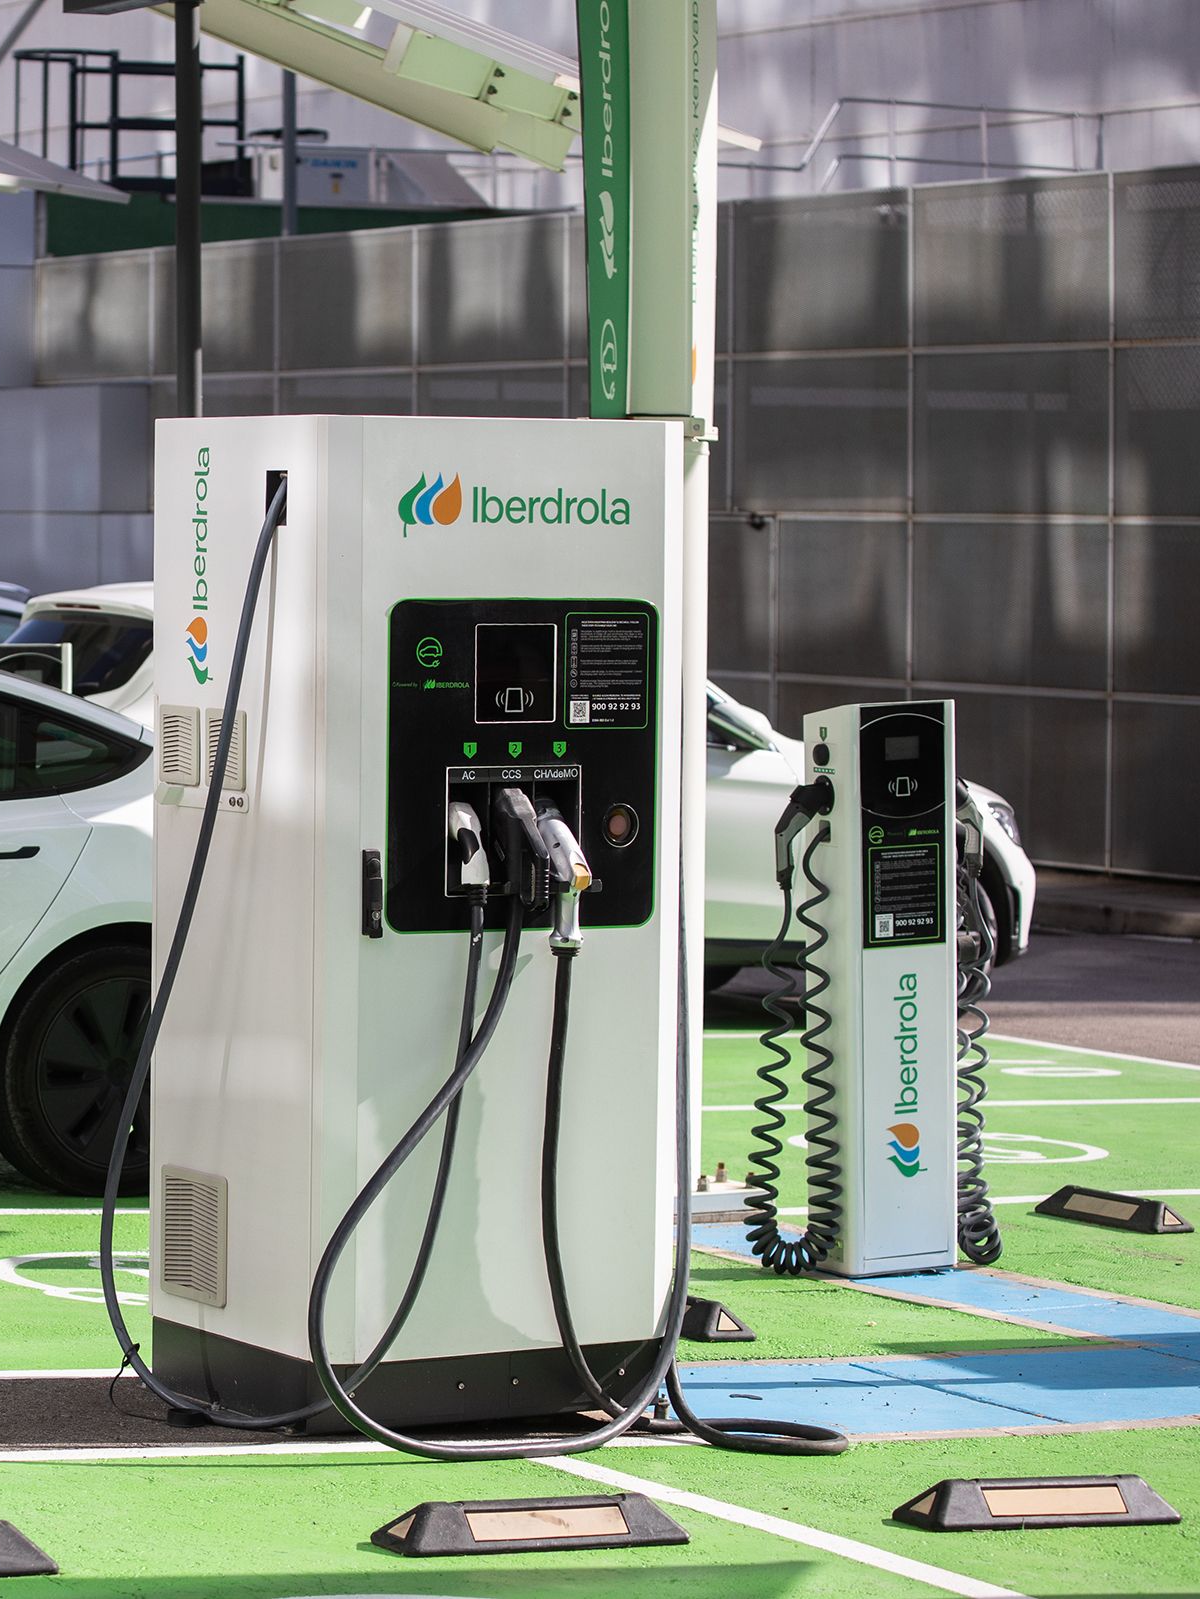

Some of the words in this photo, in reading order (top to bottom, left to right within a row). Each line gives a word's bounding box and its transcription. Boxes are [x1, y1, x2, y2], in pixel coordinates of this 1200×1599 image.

[472, 486, 631, 526] Iberdrola
[192, 447, 210, 610] Iberdrola
[591, 702, 607, 711] 900
[607, 702, 618, 711] 92
[619, 702, 629, 711] 92
[630, 702, 641, 711] 93
[461, 770, 476, 780] AC
[501, 769, 522, 779] CCS
[895, 919, 908, 927] 900
[908, 918, 916, 926] 92
[917, 917, 925, 925] 92
[925, 917, 934, 925] 93
[893, 973, 918, 1115] Iberdrola
